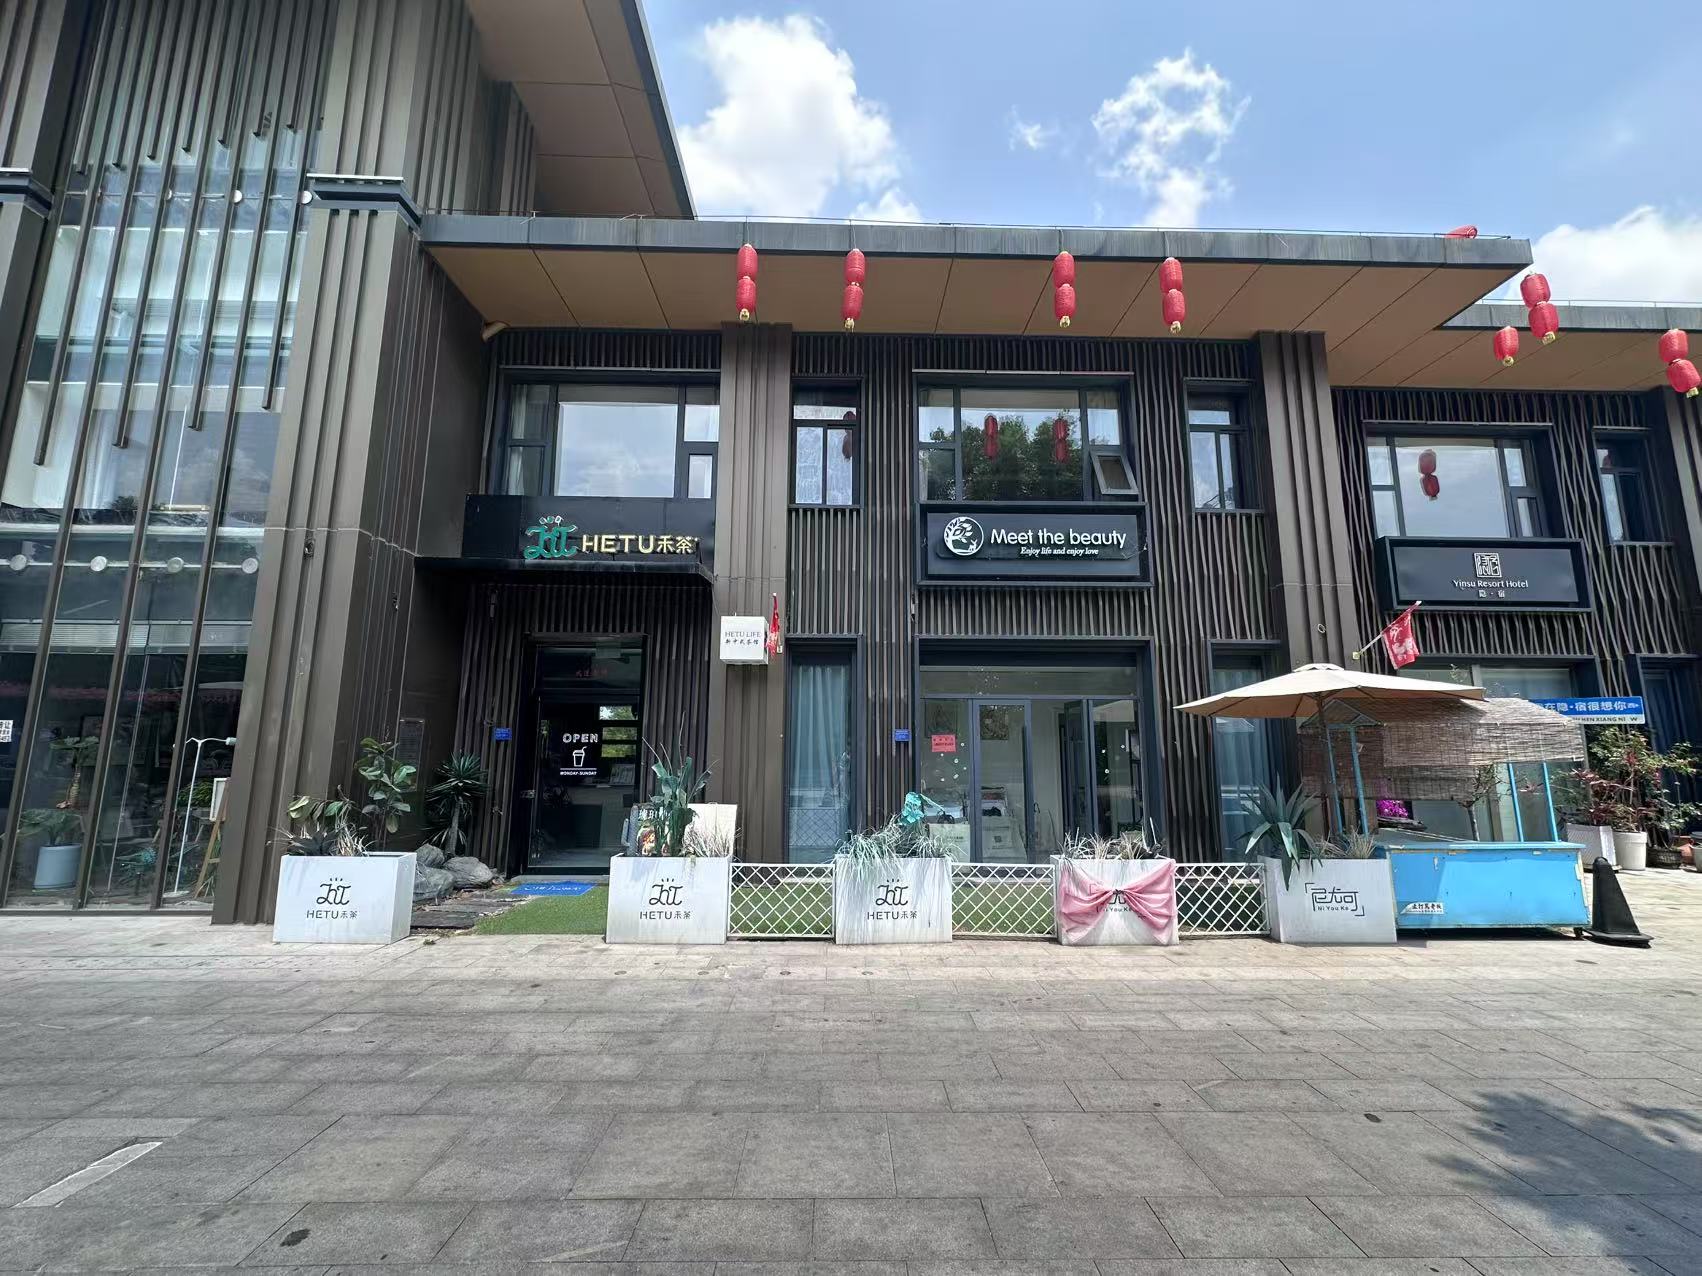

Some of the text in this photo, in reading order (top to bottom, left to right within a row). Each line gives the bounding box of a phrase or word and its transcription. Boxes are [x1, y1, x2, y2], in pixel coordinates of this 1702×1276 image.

[990, 528, 1127, 549] Meet the beauty
[1020, 546, 1099, 557] Enjoy life and enjoy love
[1453, 580, 1476, 588] Yinsu
[1538, 700, 1627, 713] 在隐·宿很想你
[563, 733, 599, 743] OPEN
